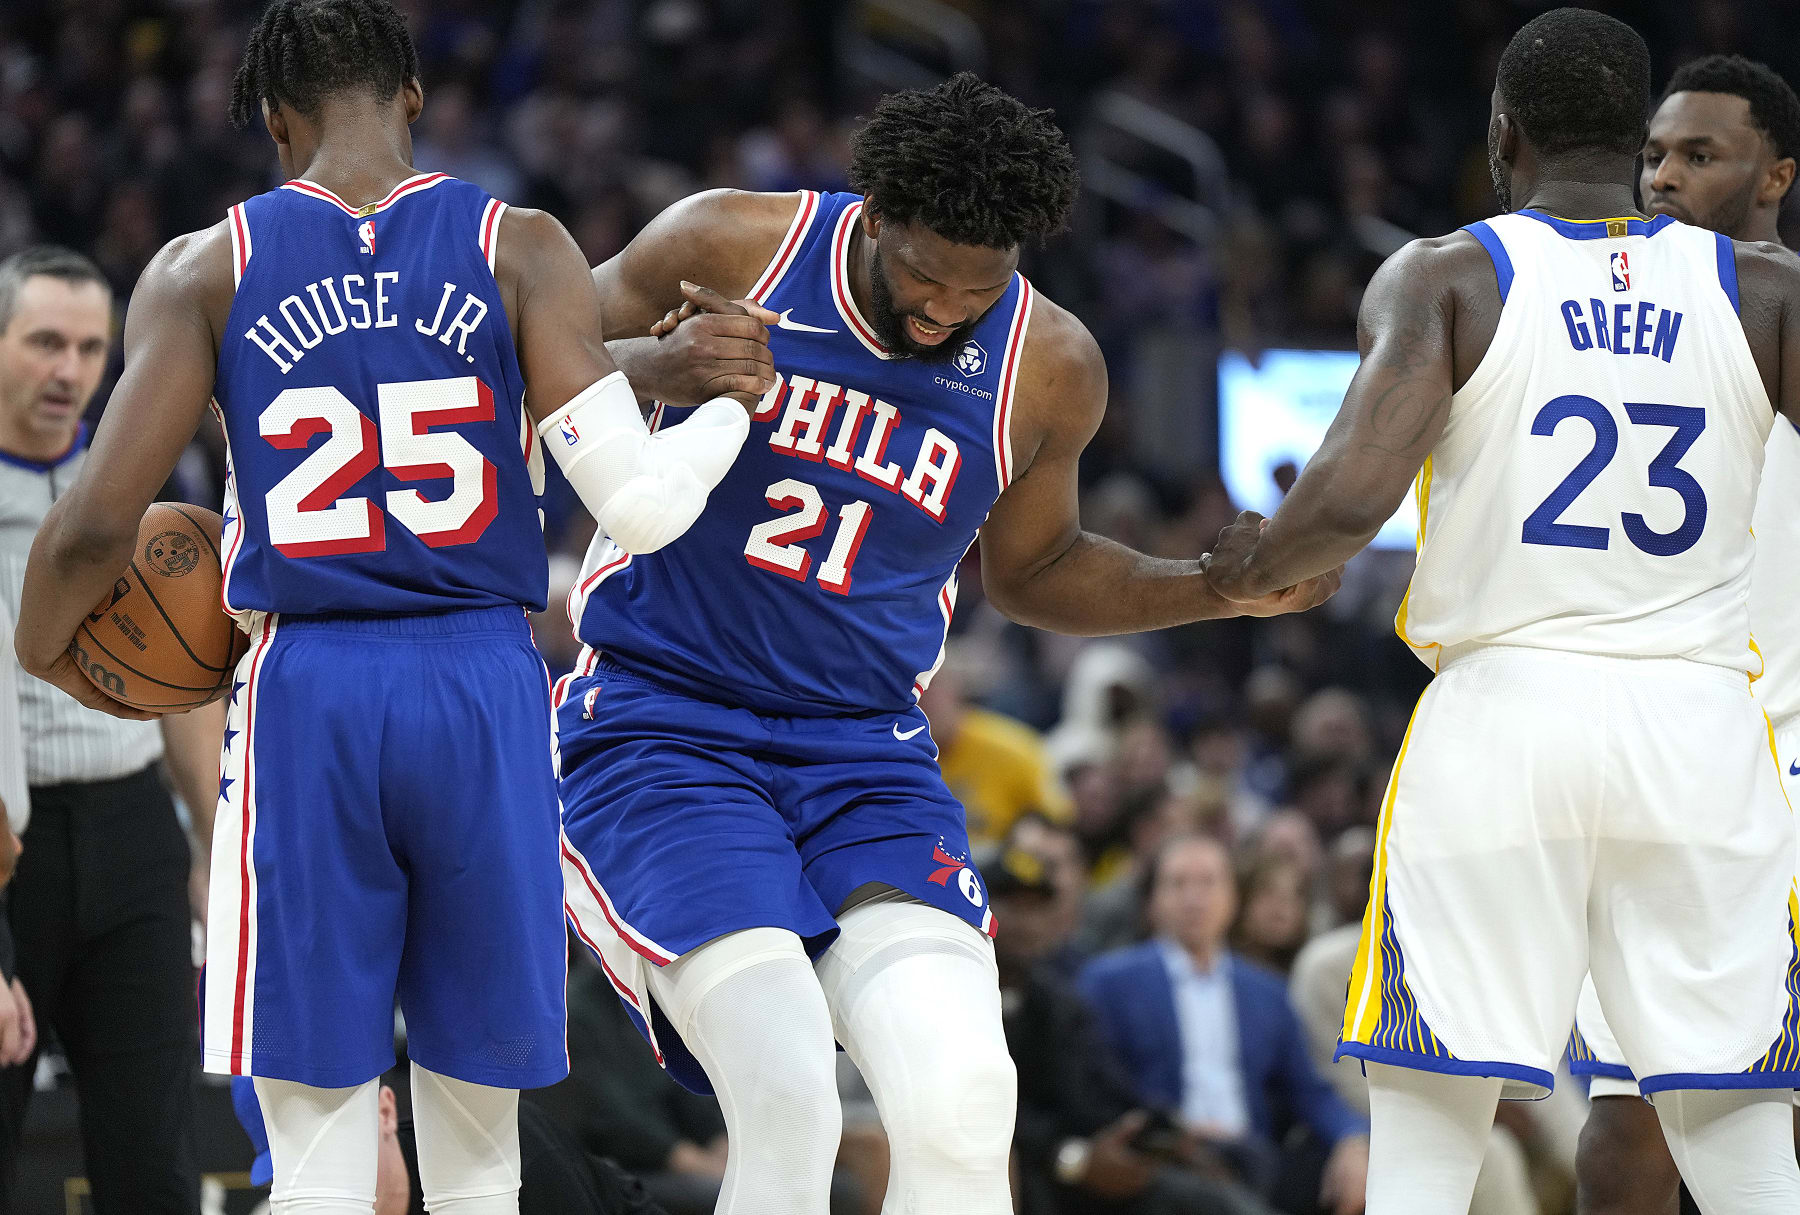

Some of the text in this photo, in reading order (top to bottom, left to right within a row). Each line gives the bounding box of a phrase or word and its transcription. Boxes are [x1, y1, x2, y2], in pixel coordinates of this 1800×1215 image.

[244, 271, 488, 375] HOUSE JR.
[1560, 297, 1684, 364] GREEN
[934, 376, 993, 401] crypto.com
[258, 376, 499, 559] 25
[1521, 394, 1708, 557] 23
[744, 478, 874, 596] 21
